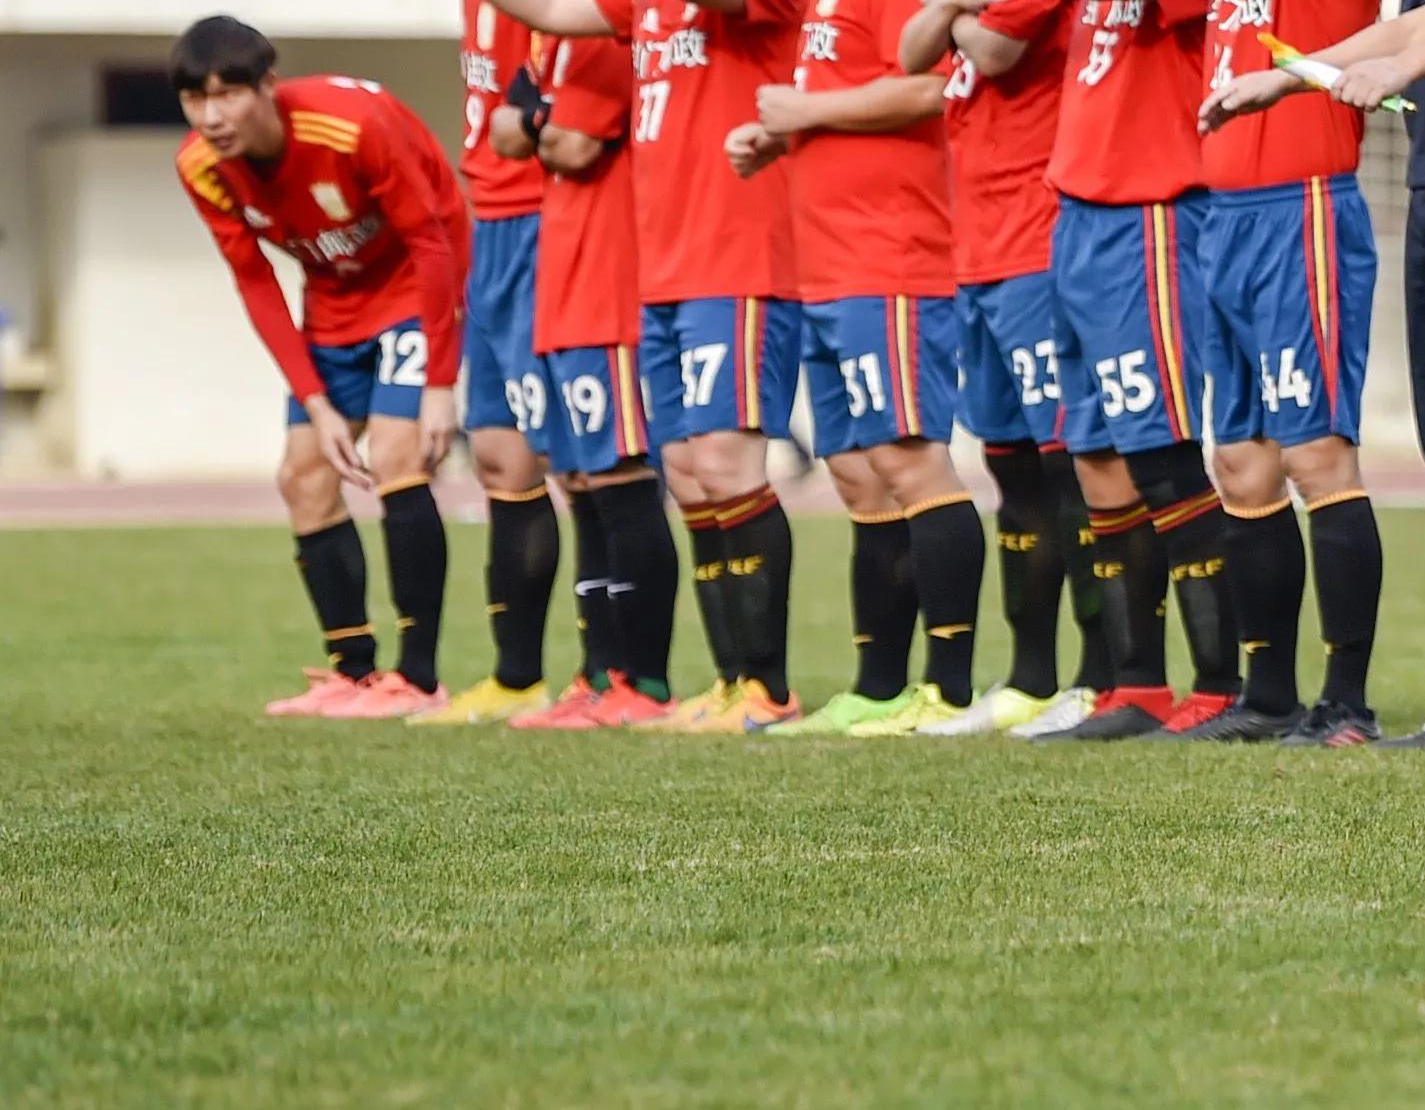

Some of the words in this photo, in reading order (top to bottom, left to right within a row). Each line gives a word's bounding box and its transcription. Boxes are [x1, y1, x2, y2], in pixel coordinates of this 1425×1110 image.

[378, 329, 428, 387] 12
[1094, 349, 1156, 418] 55
[1259, 347, 1312, 413] 44
[504, 372, 548, 432] 99
[561, 374, 607, 436] 19
